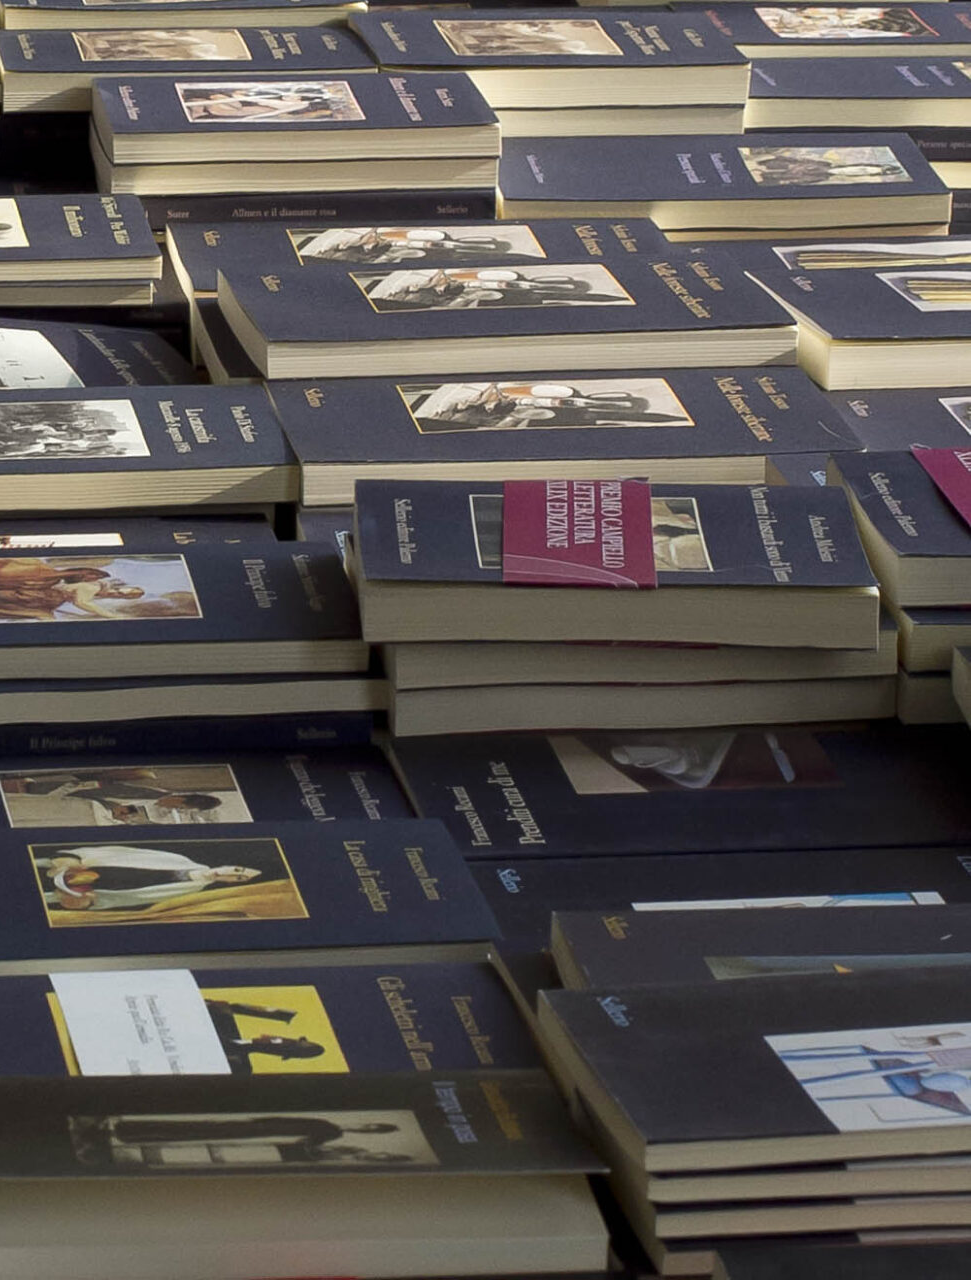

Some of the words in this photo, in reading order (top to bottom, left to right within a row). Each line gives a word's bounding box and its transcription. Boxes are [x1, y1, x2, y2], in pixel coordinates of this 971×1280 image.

[436, 205, 469, 214] Sellerio
[64, 210, 86, 238] milionario
[571, 225, 600, 238] Nelle
[202, 230, 222, 247] Sellerio
[581, 238, 606, 256] foreste
[648, 262, 679, 276] Nelle
[258, 275, 284, 293] Sellerio
[662, 276, 688, 295] foreste
[789, 276, 817, 292] Sellerio
[678, 295, 713, 319] siberiane
[711, 377, 744, 394] Nelle
[302, 388, 326, 408] Sellerio
[724, 394, 754, 413] foreste
[230, 406, 249, 419] Paolo
[847, 400, 872, 418] Sellerio
[739, 414, 773, 442] siberiane
[544, 480, 568, 500] XLIX
[599, 481, 623, 517] PREMIO
[747, 486, 771, 499] Non
[393, 499, 414, 522] Sellerio
[572, 481, 597, 545] LETTERATURA
[751, 500, 772, 514] tutti
[868, 472, 893, 495] Sellerio
[882, 494, 902, 516] editore
[895, 515, 918, 537] Palermo
[395, 523, 416, 543] editore
[545, 502, 569, 549] EDIZIONE
[756, 519, 786, 545] bastardi
[806, 515, 827, 538] Andrea
[396, 543, 417, 564] Palermo
[600, 518, 626, 569] CAMPIELLO
[762, 546, 784, 558] sono
[813, 539, 837, 562] Molesini
[243, 565, 270, 589] Principe
[252, 591, 275, 608] fulvo
[296, 727, 339, 740] Sellerio
[487, 761, 511, 777] me
[486, 777, 516, 786] di
[447, 785, 477, 811] Recami
[496, 787, 531, 809] cura
[462, 810, 493, 846] Francesco
[504, 808, 546, 845] Prenditi
[340, 840, 367, 850] La
[347, 852, 373, 870] casa
[401, 847, 431, 874] Francesco
[353, 871, 382, 879] di
[495, 868, 524, 893] Sellerio
[354, 880, 391, 913] ringhiera
[600, 915, 630, 940] Sellerio
[374, 976, 404, 990] Gli
[380, 991, 421, 1029] scheletri
[448, 996, 484, 1035] Francesco
[594, 995, 634, 1027] Sellerio
[434, 1088, 465, 1112] tempo
[446, 1124, 480, 1143] posa
